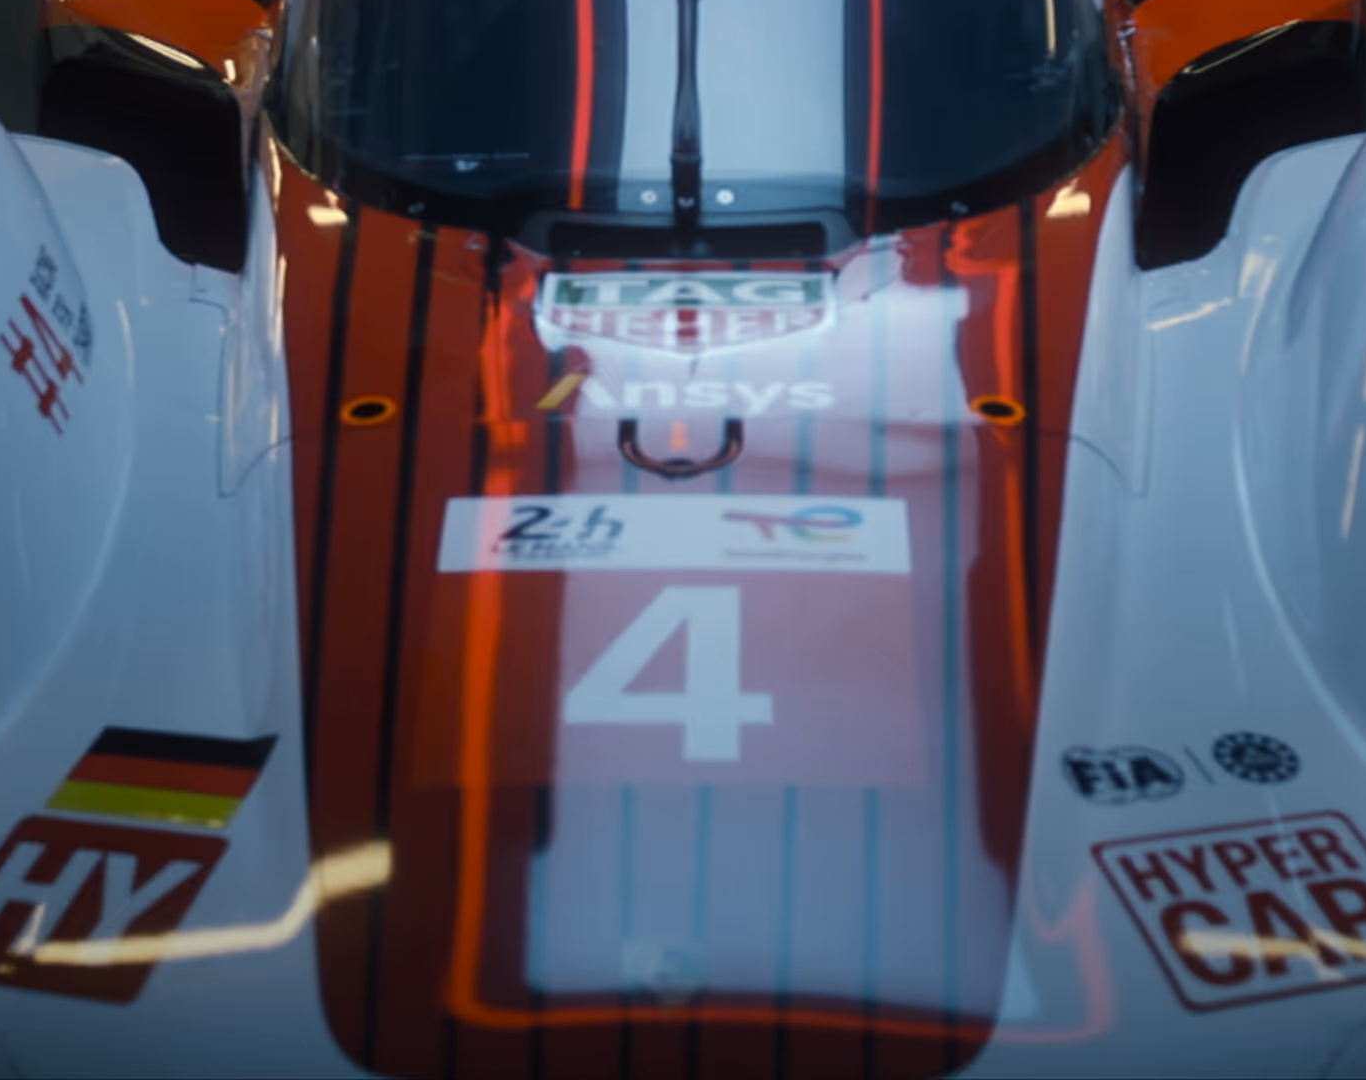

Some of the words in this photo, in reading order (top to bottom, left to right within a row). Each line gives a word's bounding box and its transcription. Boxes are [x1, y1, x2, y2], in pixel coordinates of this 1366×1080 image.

[570, 279, 805, 304] TAG
[535, 373, 834, 415] Ansys
[564, 585, 774, 762] 4
[1067, 755, 1175, 798] FIA
[1117, 825, 1362, 904] HYPER
